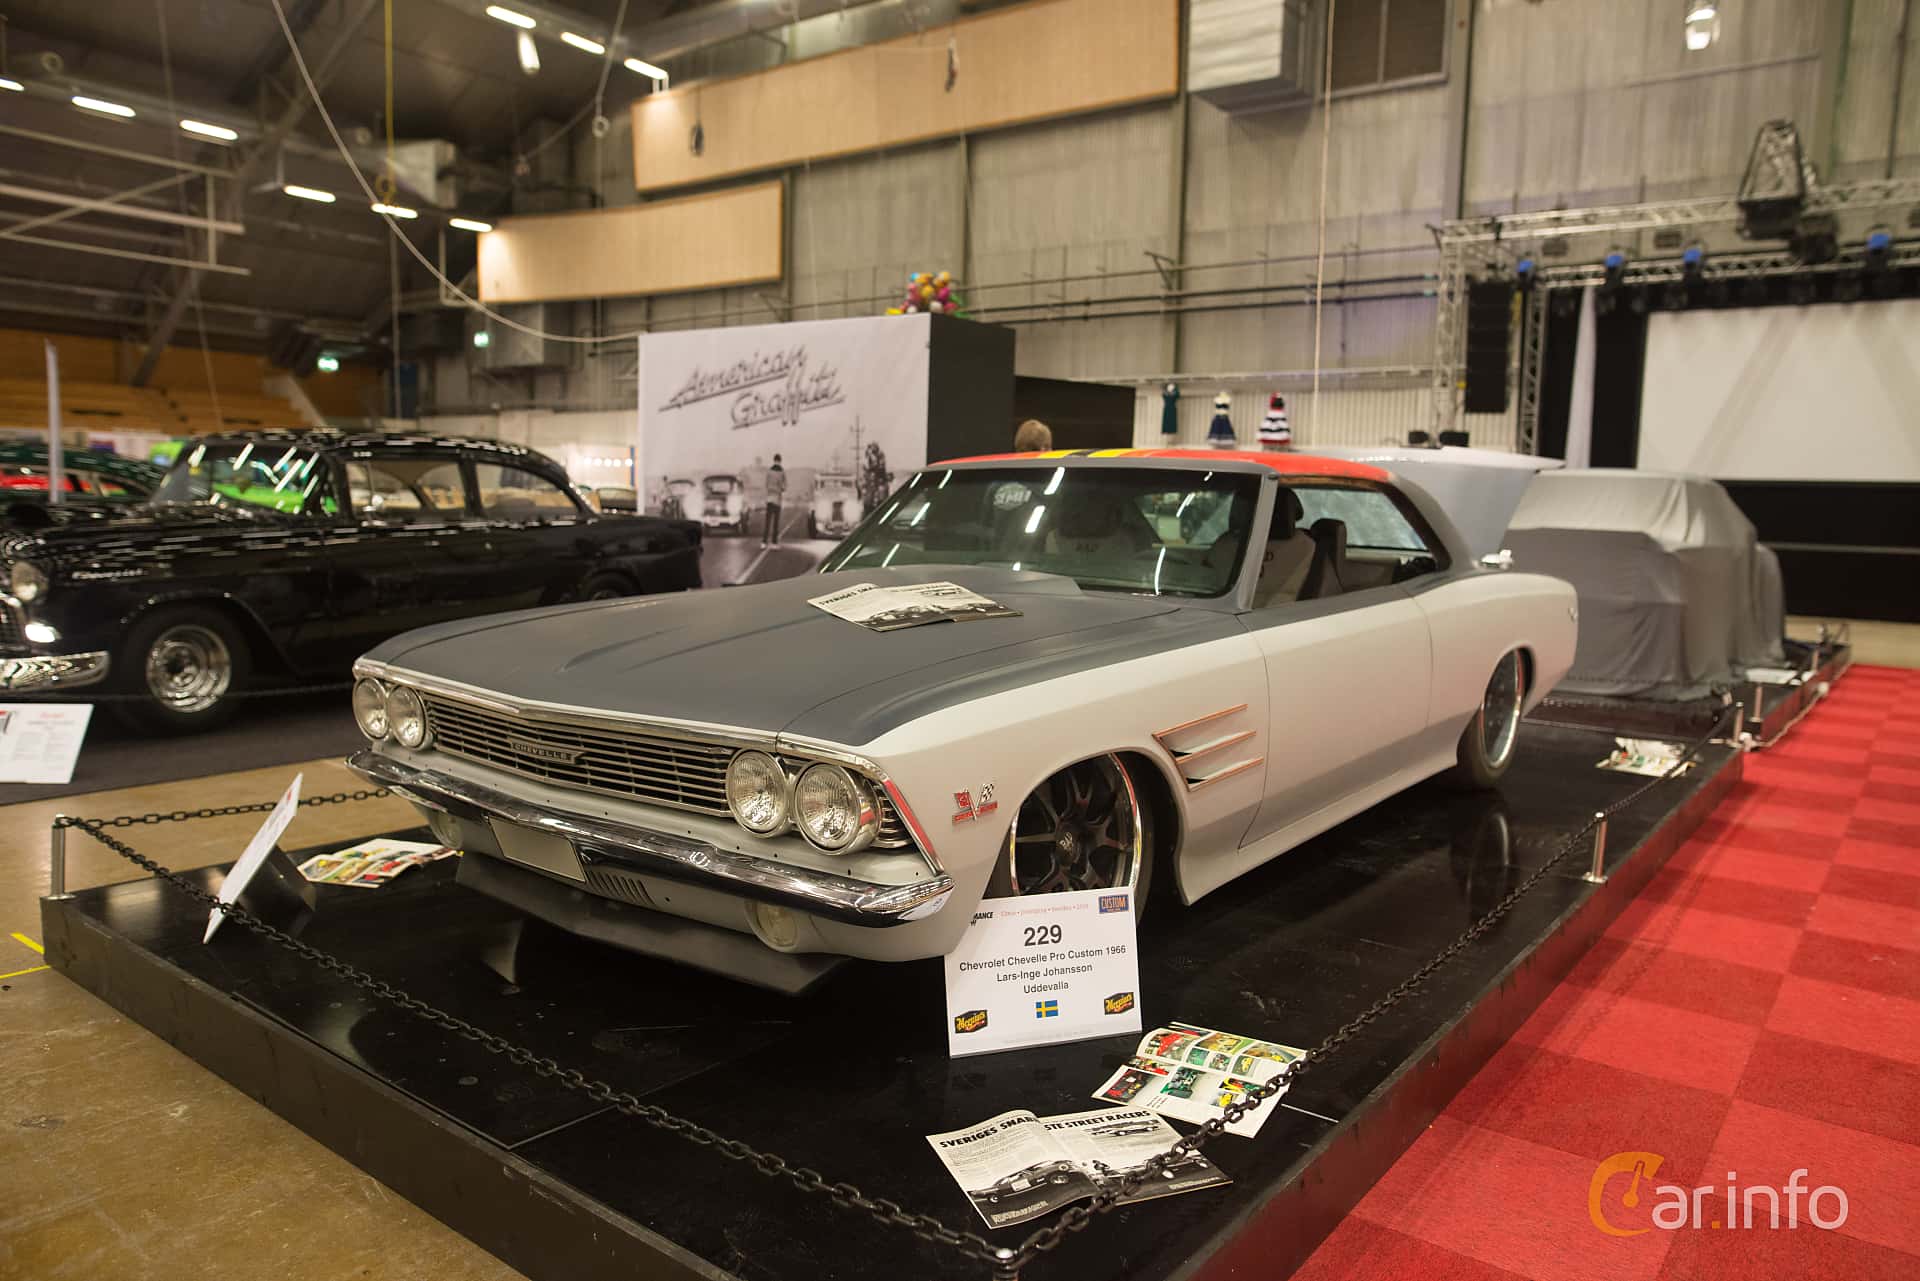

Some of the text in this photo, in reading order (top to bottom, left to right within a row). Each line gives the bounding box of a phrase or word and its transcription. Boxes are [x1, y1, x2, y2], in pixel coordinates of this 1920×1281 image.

[659, 345, 809, 411] American
[730, 362, 847, 429] Graffiti
[515, 743, 570, 761] CHEVELLE
[1023, 924, 1062, 947] 229
[959, 944, 1127, 972] Chevrolet Chevelle Pro Custom 1966
[996, 963, 1093, 982] Lars-Inge Johansson
[1023, 981, 1069, 995] Uddevalla
[939, 1126, 998, 1149] SVERIGES
[1044, 1123, 1065, 1131] STE
[1065, 1117, 1105, 1128] STREET
[1105, 1110, 1151, 1122] RACERS
